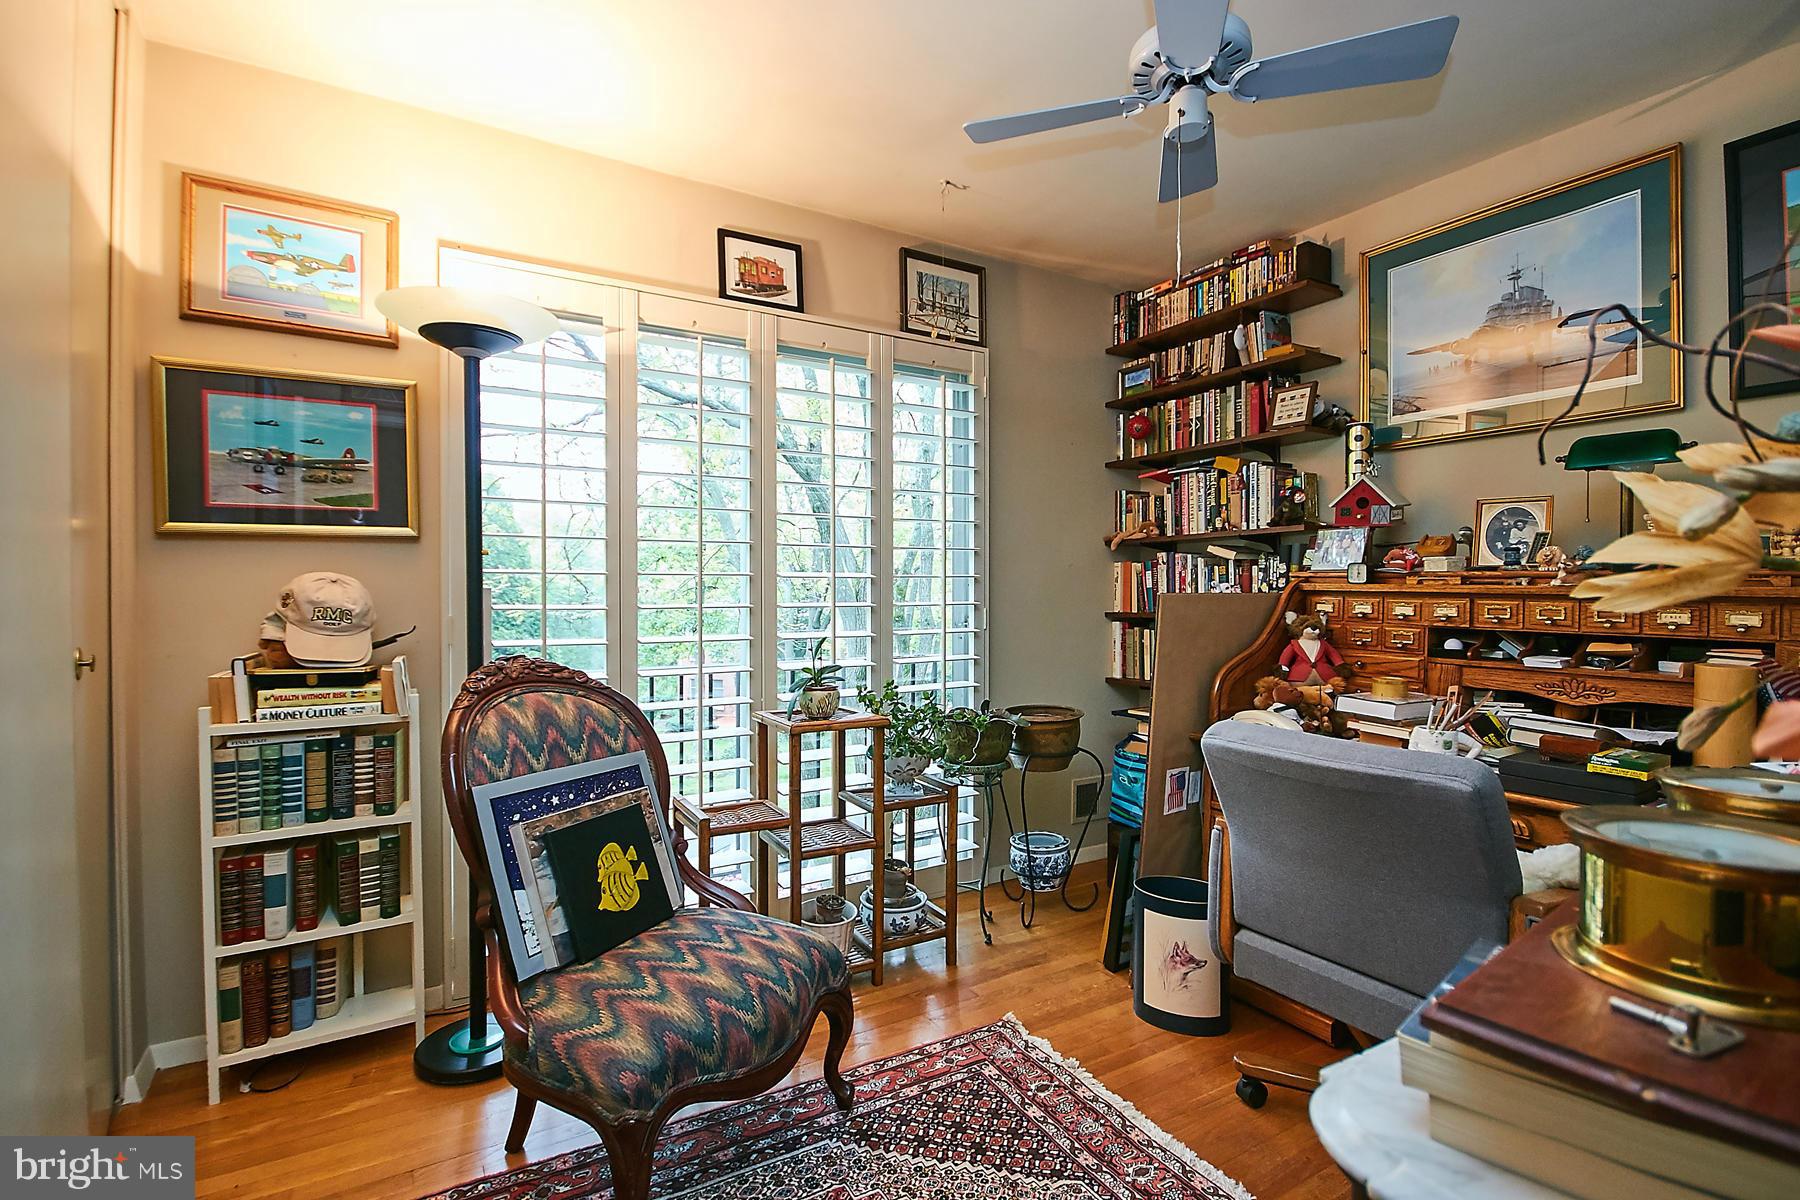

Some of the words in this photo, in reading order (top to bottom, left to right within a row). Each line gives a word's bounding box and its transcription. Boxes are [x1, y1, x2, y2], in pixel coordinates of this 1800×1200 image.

[311, 606, 353, 624] RMC
[272, 694, 300, 702] WEALTH
[301, 692, 331, 701] WITHOUT
[332, 691, 347, 699] RISK
[269, 709, 304, 721] MONEY
[305, 707, 348, 719] CULTURE
